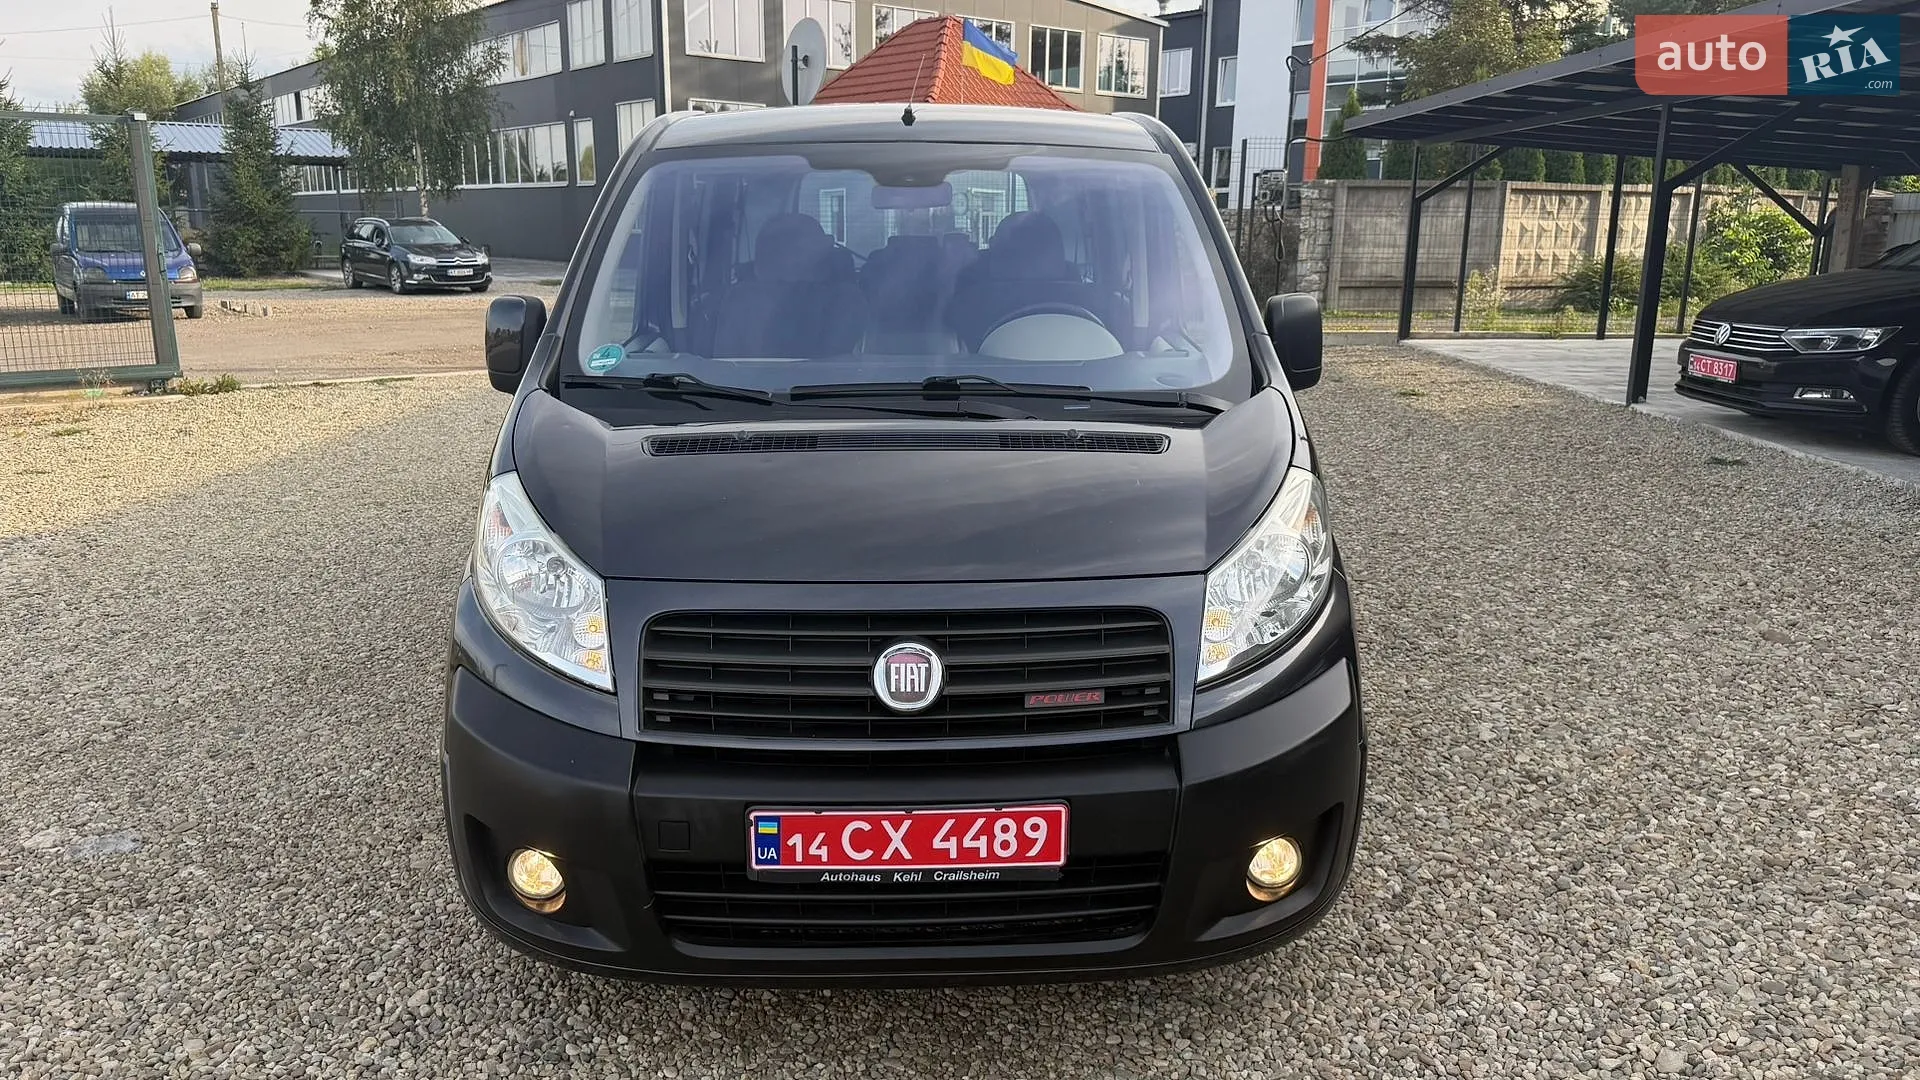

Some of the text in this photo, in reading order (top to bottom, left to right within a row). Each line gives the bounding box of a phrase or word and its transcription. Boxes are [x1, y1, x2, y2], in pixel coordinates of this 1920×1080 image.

[1700, 360, 1712, 373] CT
[1713, 362, 1734, 377] 8317
[890, 663, 928, 693] FIAT
[1029, 691, 1102, 706] POWER
[786, 816, 1048, 862] 14 CX 4489
[758, 847, 777, 860] UA
[820, 870, 1000, 883] Autohaus Kehl Crailsheim
